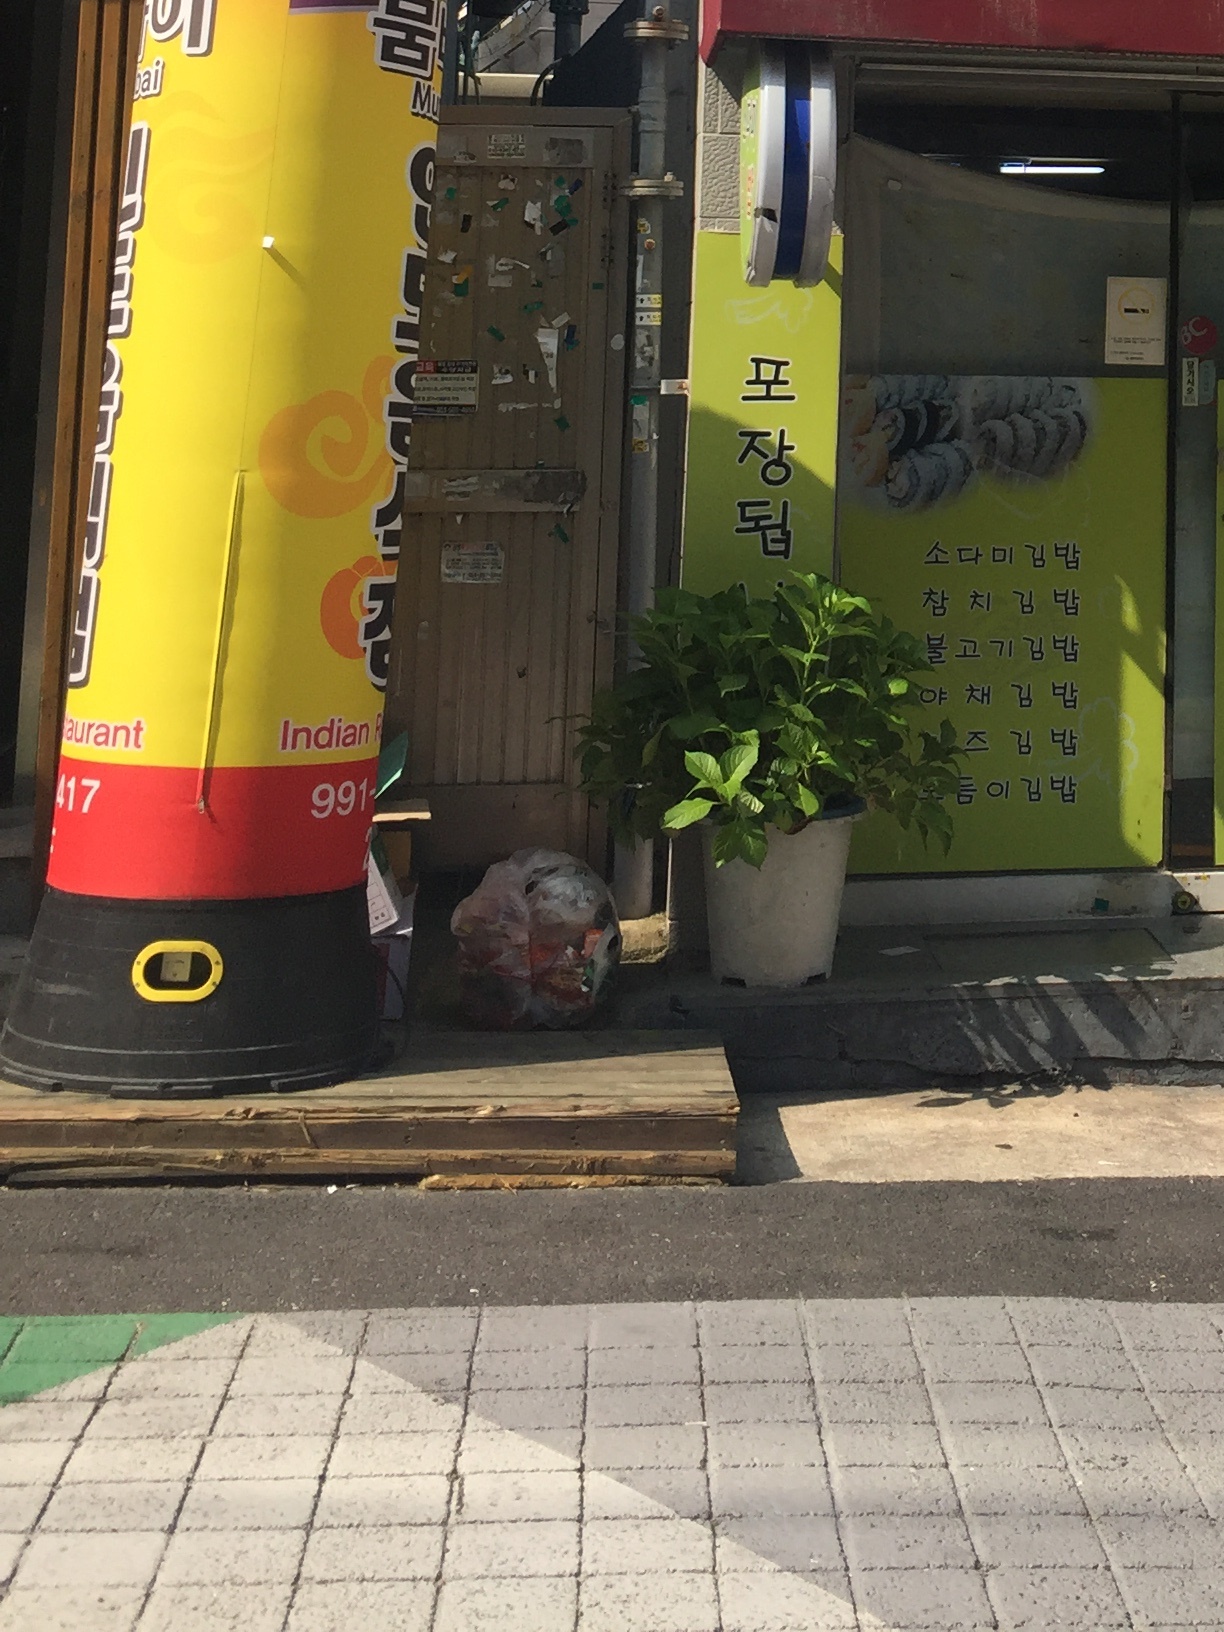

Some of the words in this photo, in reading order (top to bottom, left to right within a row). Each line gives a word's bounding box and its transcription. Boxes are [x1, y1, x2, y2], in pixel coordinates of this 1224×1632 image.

[1181, 316, 1209, 345] BC
[734, 356, 797, 603] 포장됩
[923, 540, 1081, 571] 소다미김밥
[926, 633, 1080, 665] 불고기김밥
[63, 717, 144, 750] aurant
[280, 717, 370, 751] Indian
[930, 728, 1078, 757] 즈김밥
